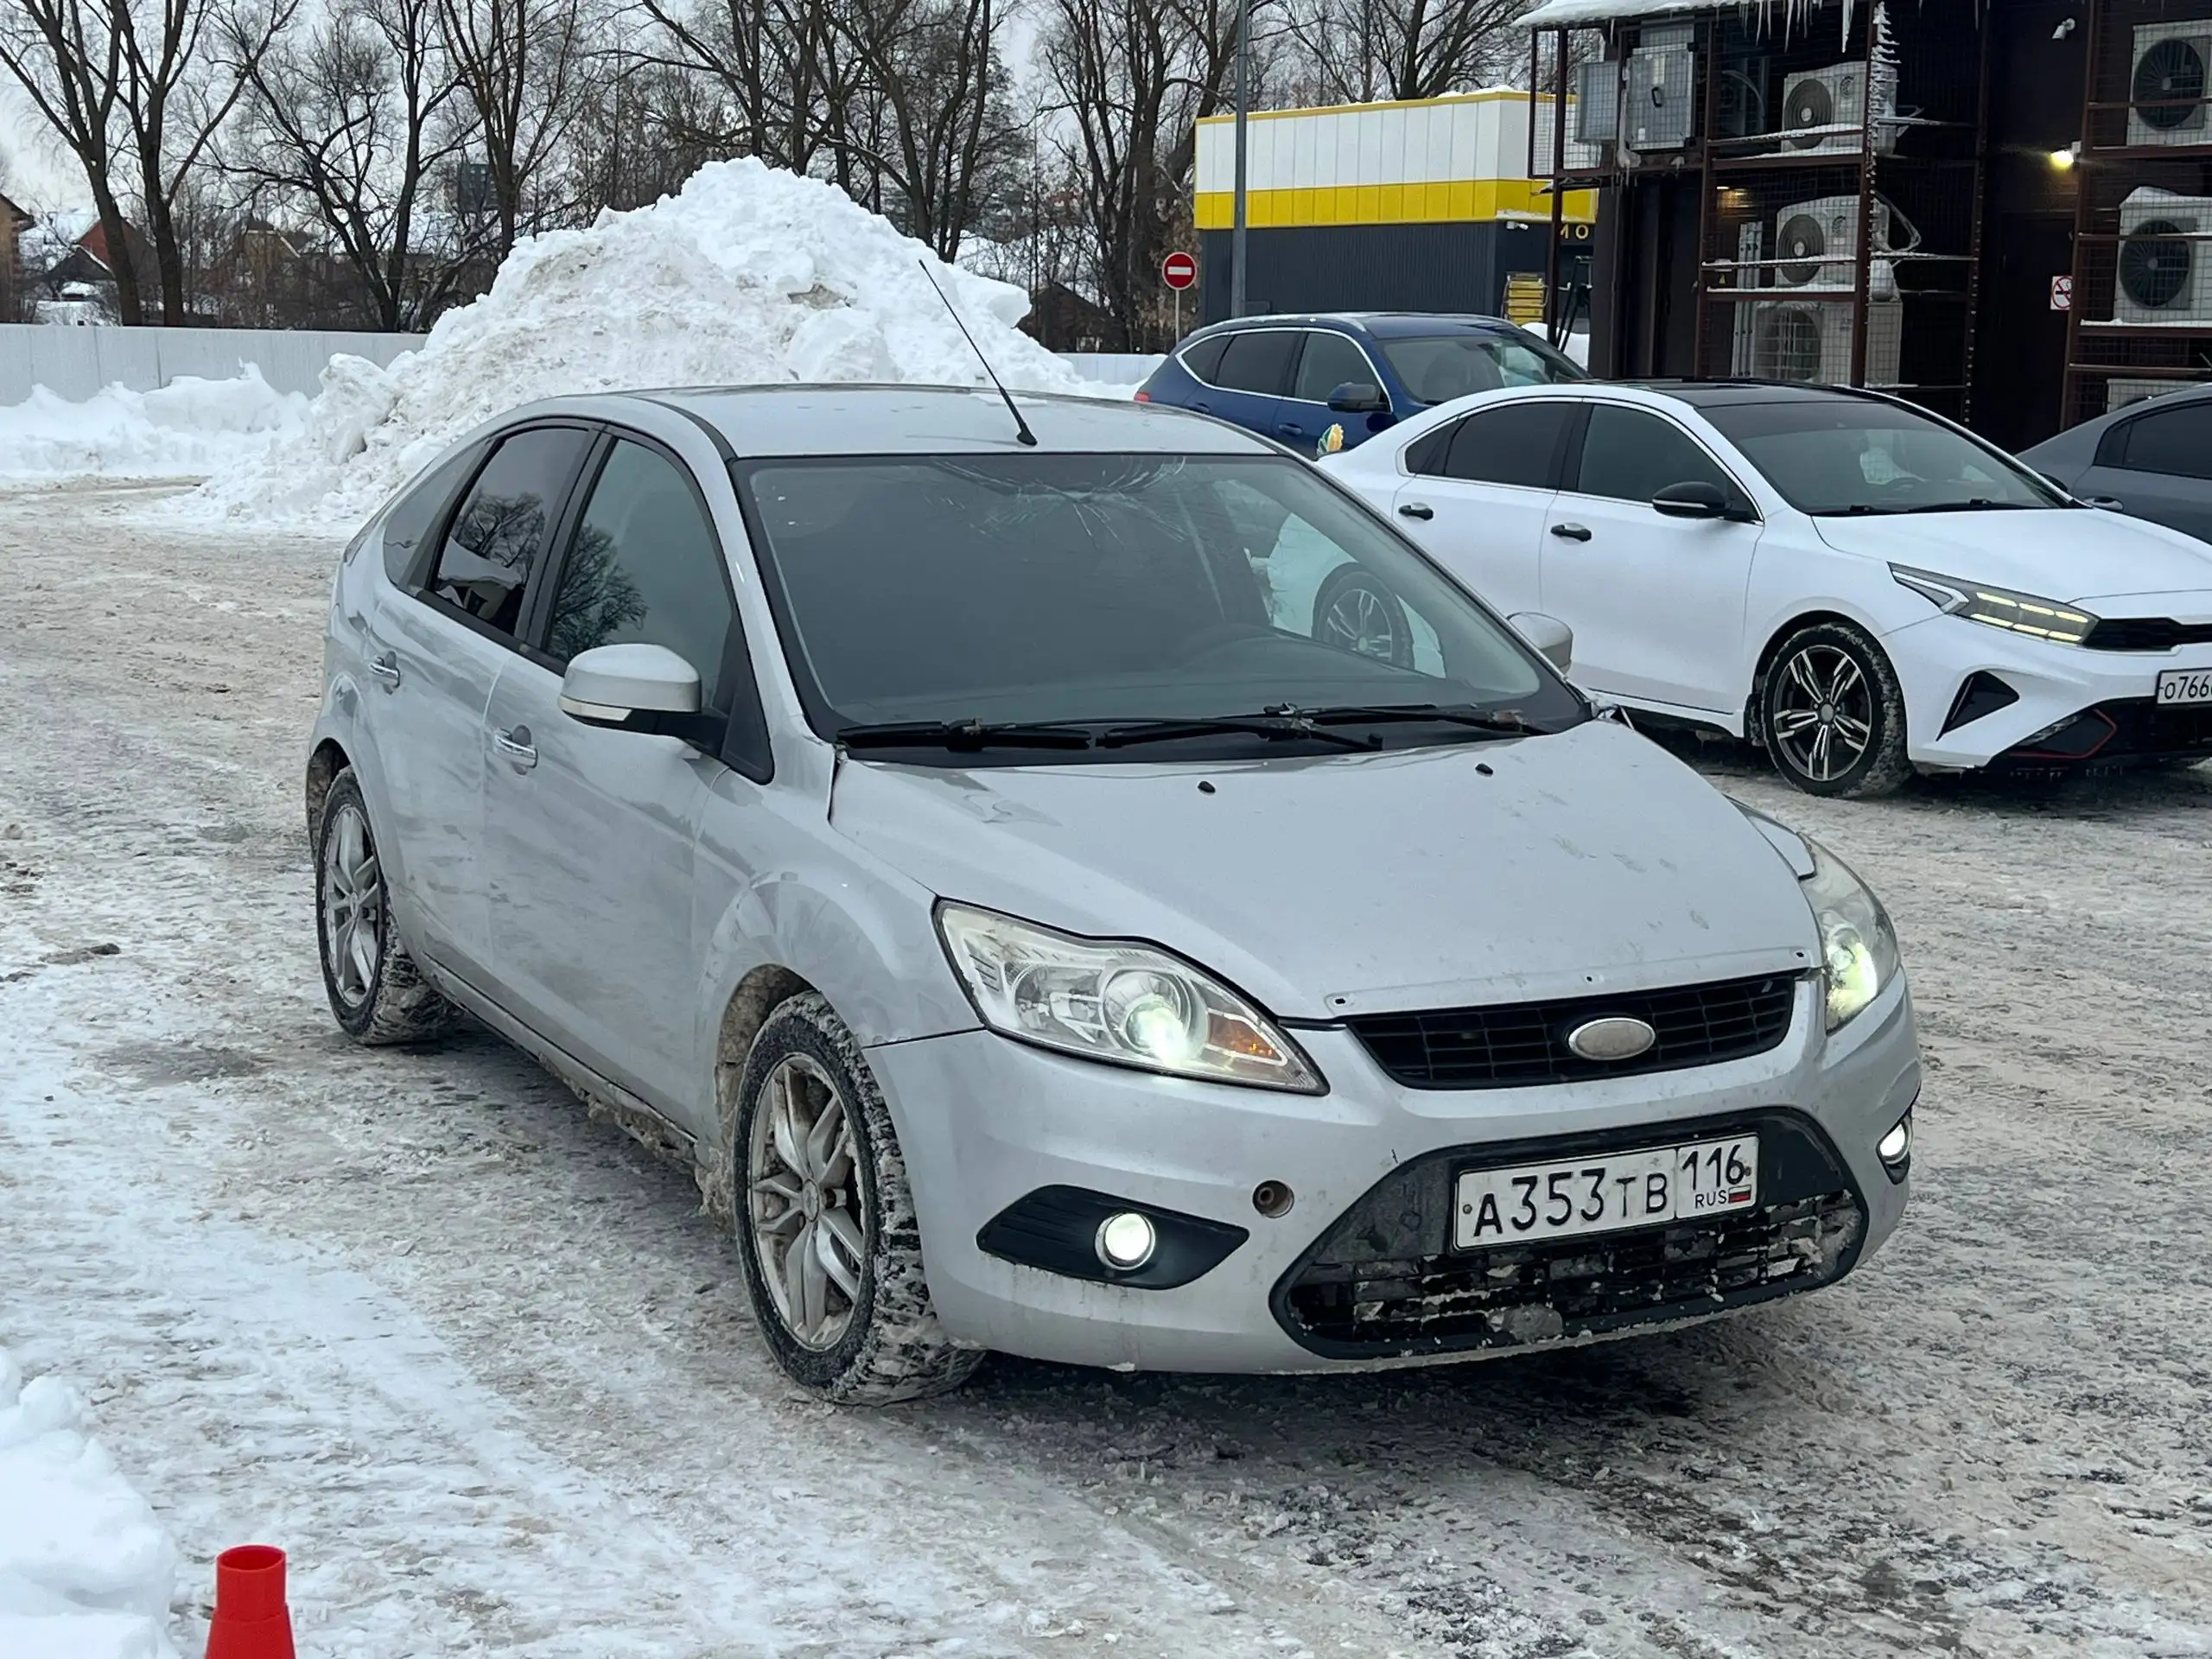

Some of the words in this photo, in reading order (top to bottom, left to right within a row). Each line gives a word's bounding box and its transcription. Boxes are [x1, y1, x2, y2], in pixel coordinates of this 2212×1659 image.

[2164, 675, 2212, 699] О766
[1681, 1145, 1745, 1191] 116
[1694, 1190, 1727, 1209] RUS
